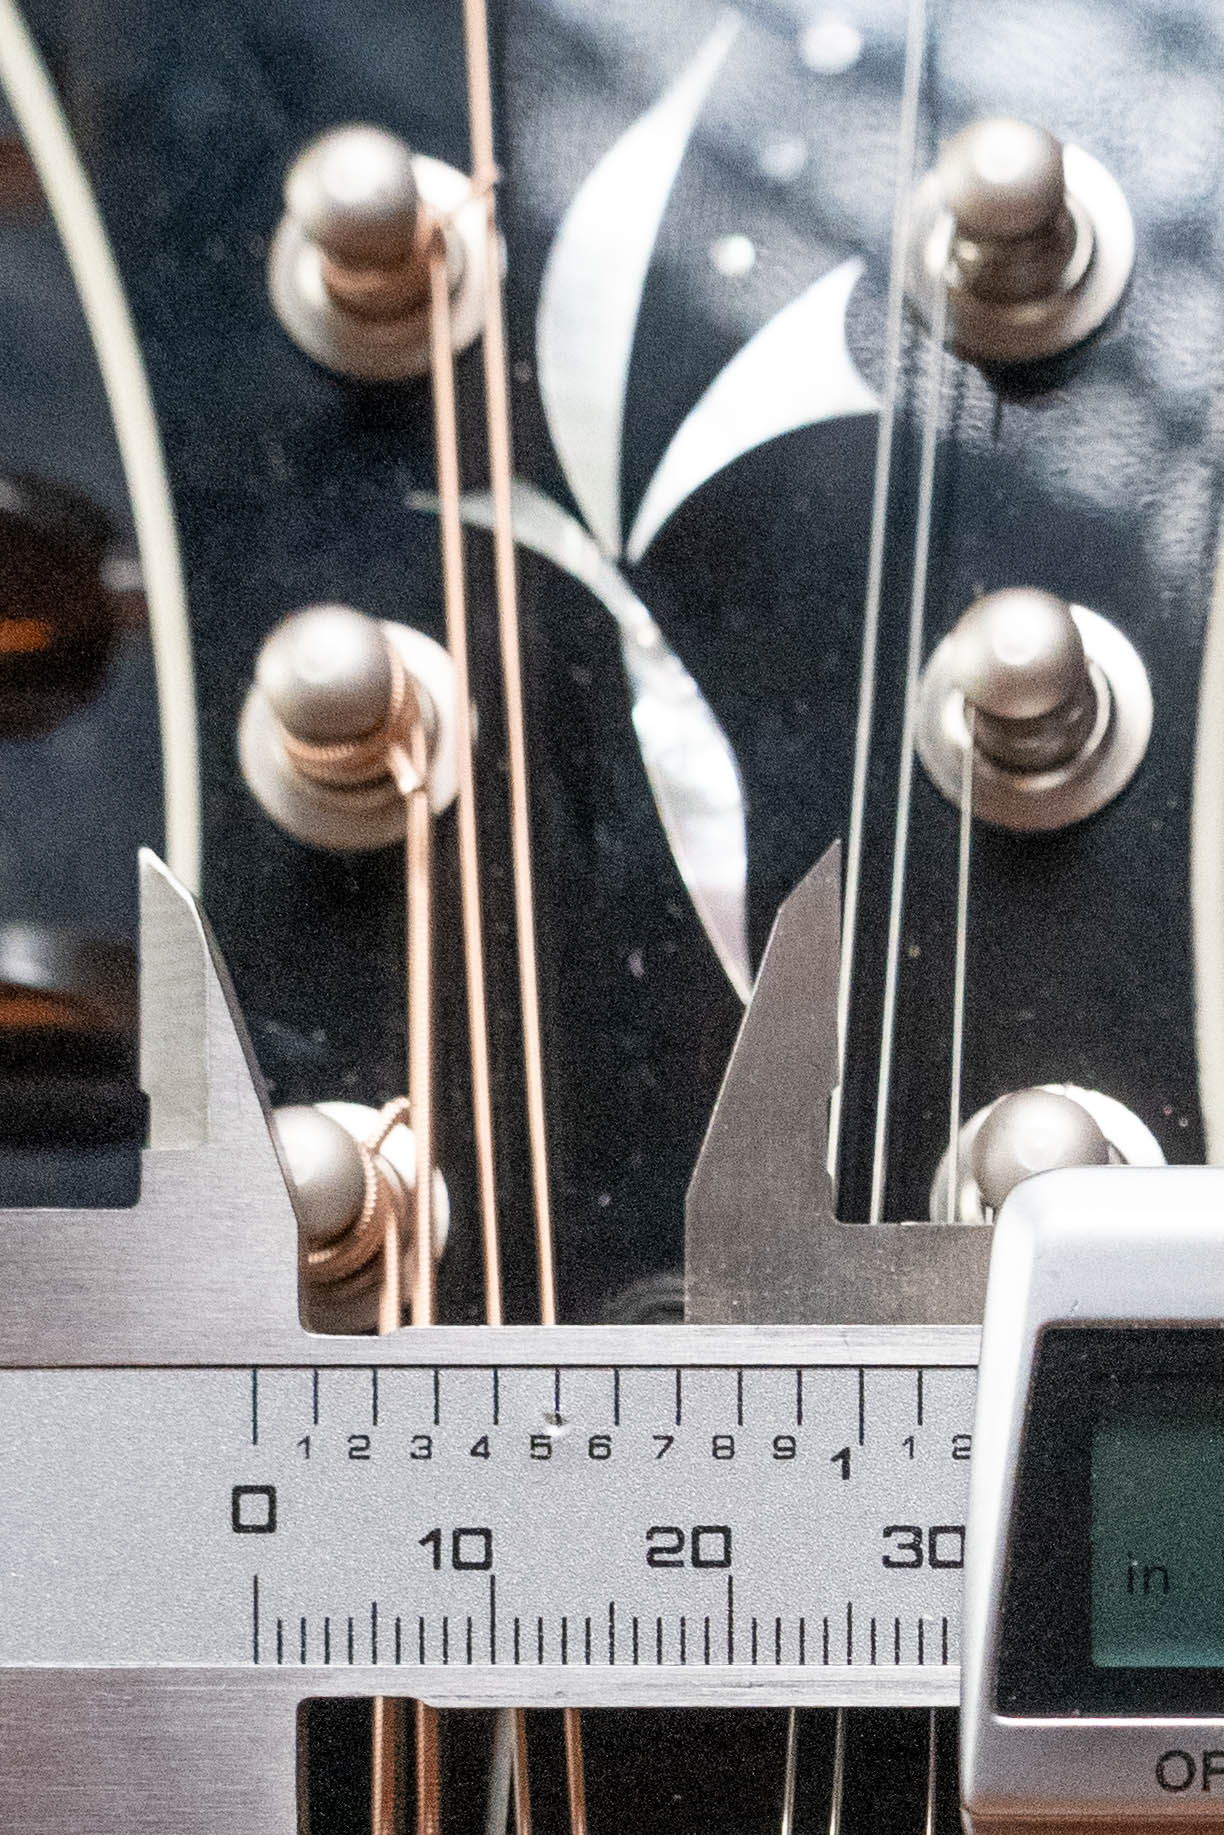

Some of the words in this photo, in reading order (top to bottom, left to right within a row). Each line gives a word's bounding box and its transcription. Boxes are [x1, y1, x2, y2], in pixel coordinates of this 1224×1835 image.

[297, 1435, 311, 1460] 1
[347, 1434, 371, 1461] 2
[409, 1434, 433, 1460] 3
[469, 1435, 491, 1460] 4
[529, 1433, 553, 1461] 5
[588, 1434, 612, 1461] 6
[652, 1434, 675, 1460] 7
[711, 1434, 736, 1460] 8
[772, 1434, 797, 1461] 9
[830, 1446, 851, 1481] 1
[902, 1435, 914, 1459] 1
[230, 1484, 278, 1535] 0
[418, 1527, 493, 1572] 10
[645, 1524, 732, 1570] 20
[882, 1524, 965, 1570] 30
[1124, 1552, 1172, 1597] in
